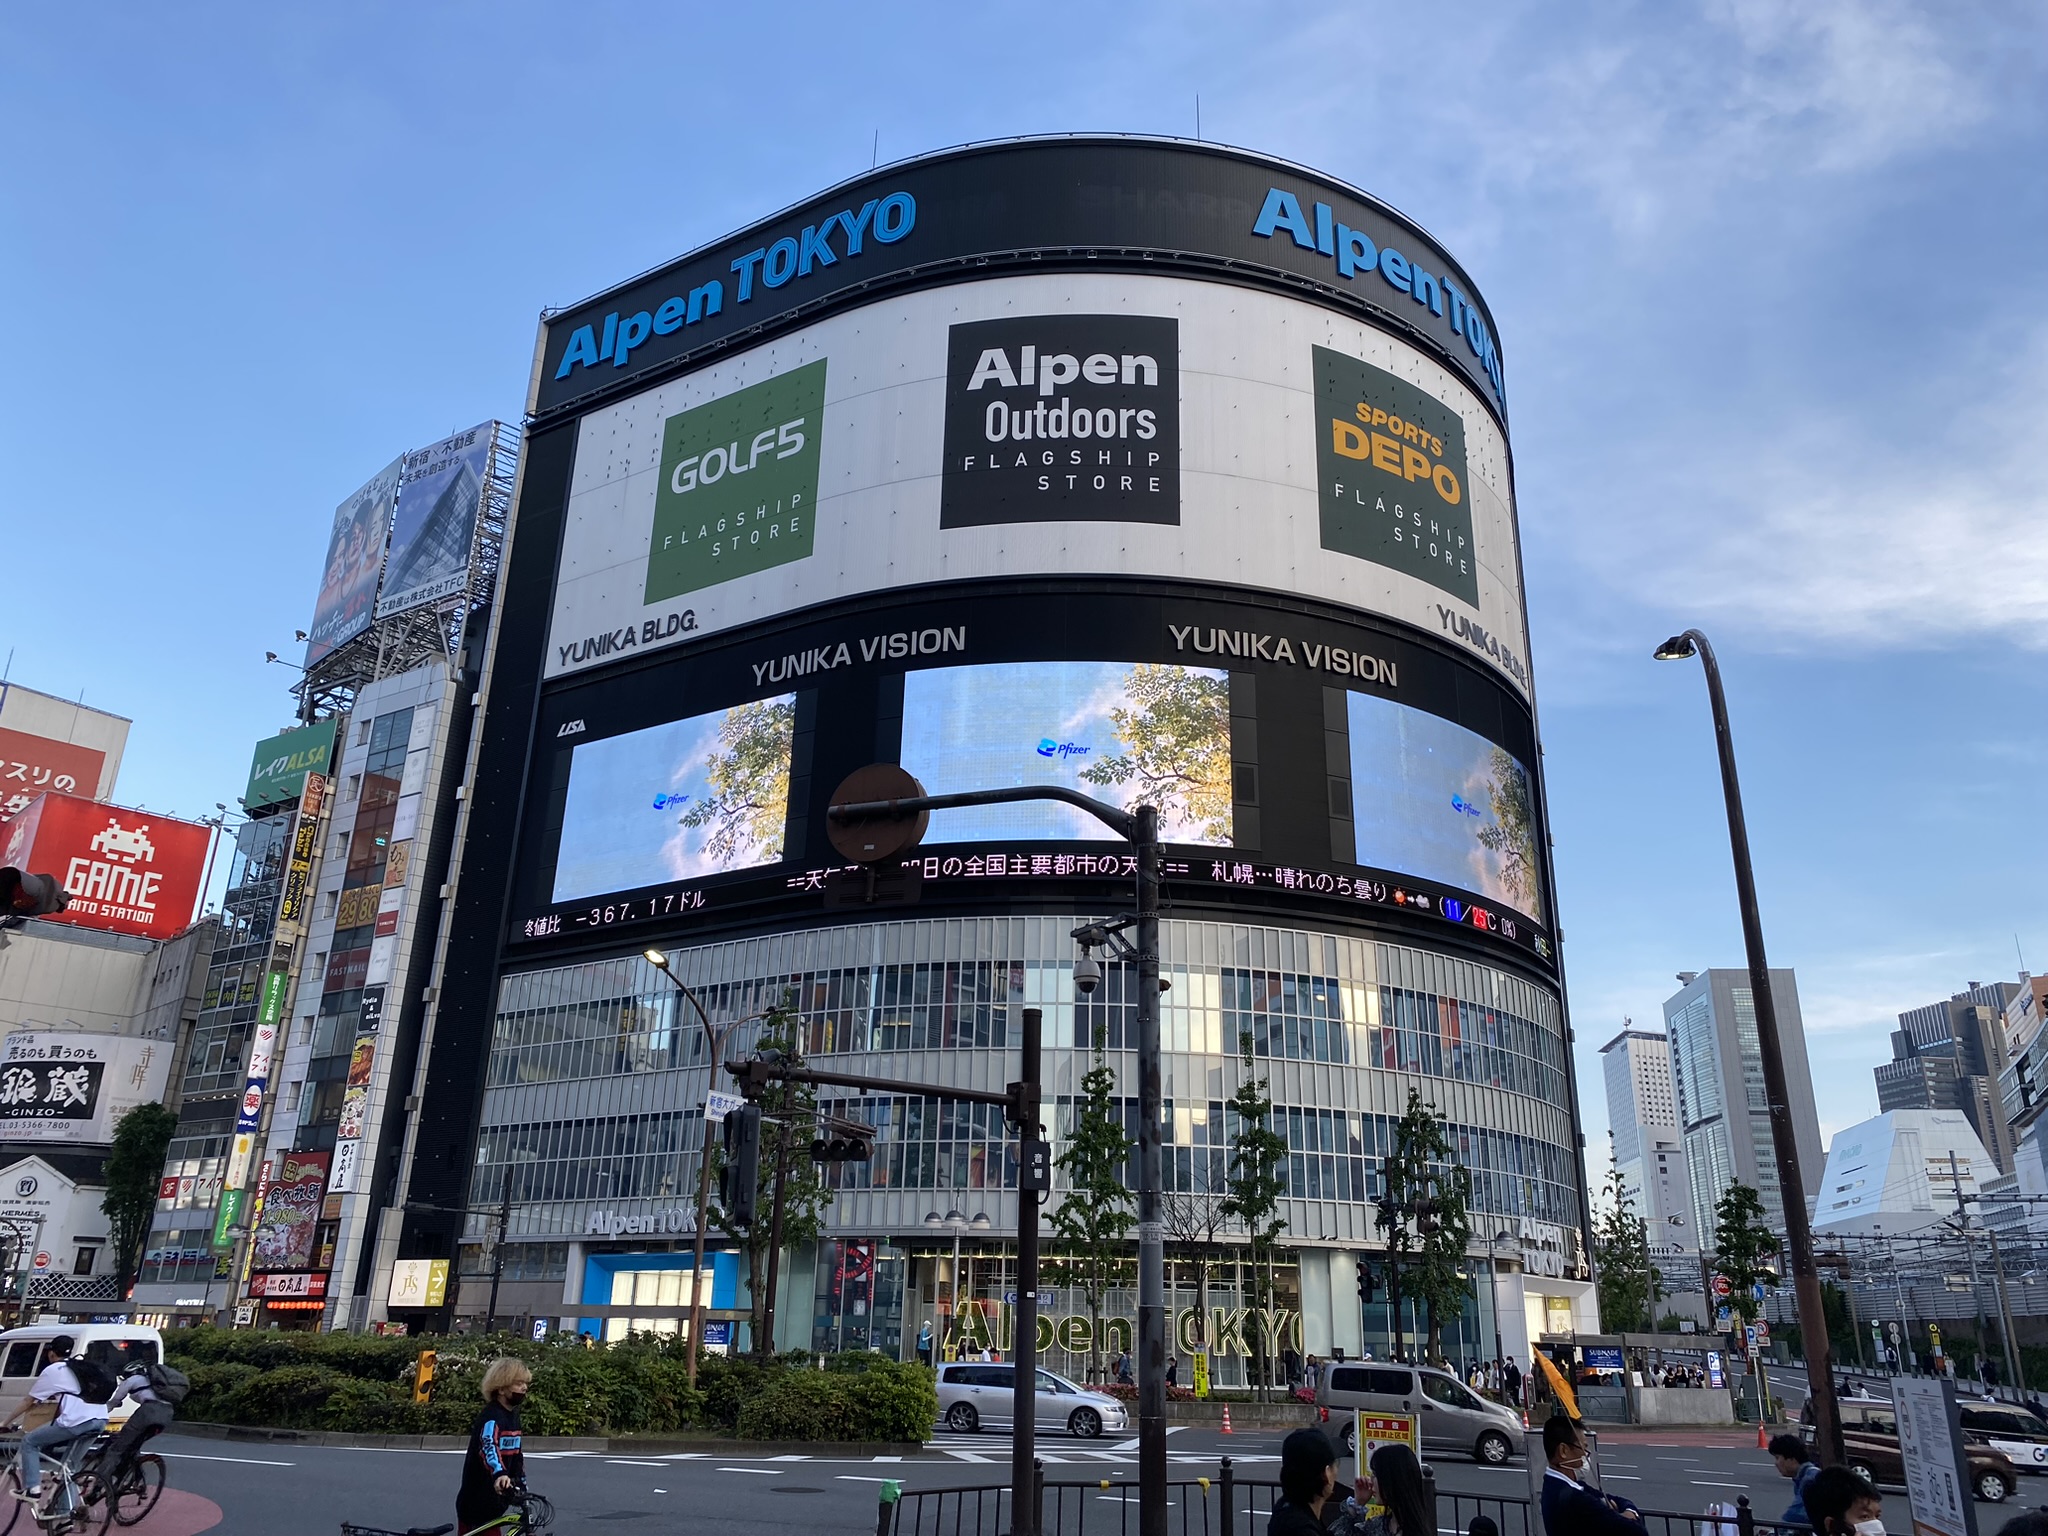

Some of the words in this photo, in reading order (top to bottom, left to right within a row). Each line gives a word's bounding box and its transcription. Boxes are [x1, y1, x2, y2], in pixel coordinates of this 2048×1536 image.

[554, 278, 725, 381] Alpen
[730, 191, 917, 303] TOKYO
[1251, 187, 1442, 318] Alpen
[1441, 275, 1501, 402] TOKY
[966, 345, 1158, 396] Alpen
[985, 397, 1157, 442] Outdoors
[1355, 402, 1443, 457] SPORTS
[671, 417, 805, 494] GOLF5
[964, 450, 1160, 471] FLAGSHIP
[1332, 418, 1461, 505] DEPO
[1037, 475, 1160, 492] STORE
[663, 493, 801, 550] FLAGSHIP
[1335, 483, 1465, 549] FLAGSHIP
[712, 517, 799, 556] STORE
[1394, 527, 1467, 575] STORE
[558, 625, 637, 667] YUNIKA
[642, 609, 699, 645] BLDG.
[1436, 603, 1501, 663] YUNIKA
[752, 642, 852, 686] YUNIKA
[859, 626, 966, 664] VISION
[1168, 624, 1296, 664] YUNIKA
[1300, 640, 1398, 687] VISION
[253, 744, 326, 781] レイクALSA
[1057, 741, 1091, 759] Pfizer
[0, 760, 76, 793] スリの
[666, 792, 690, 808] Pfizer
[296, 826, 306, 853] Table
[301, 825, 315, 858] Cheese
[63, 856, 163, 910] GAME
[67, 899, 98, 915] AITO
[100, 902, 155, 924] STATION
[7, 1036, 34, 1046] ブランド品
[243, 1092, 260, 1110] 薬
[164, 1182, 175, 1195] 3F
[585, 1210, 654, 1240] Alpen
[656, 1206, 725, 1232] TOK
[1519, 1215, 1562, 1247] Alpen
[1522, 1247, 1565, 1279] TOKYO
[278, 1276, 303, 1293] 日高屋
